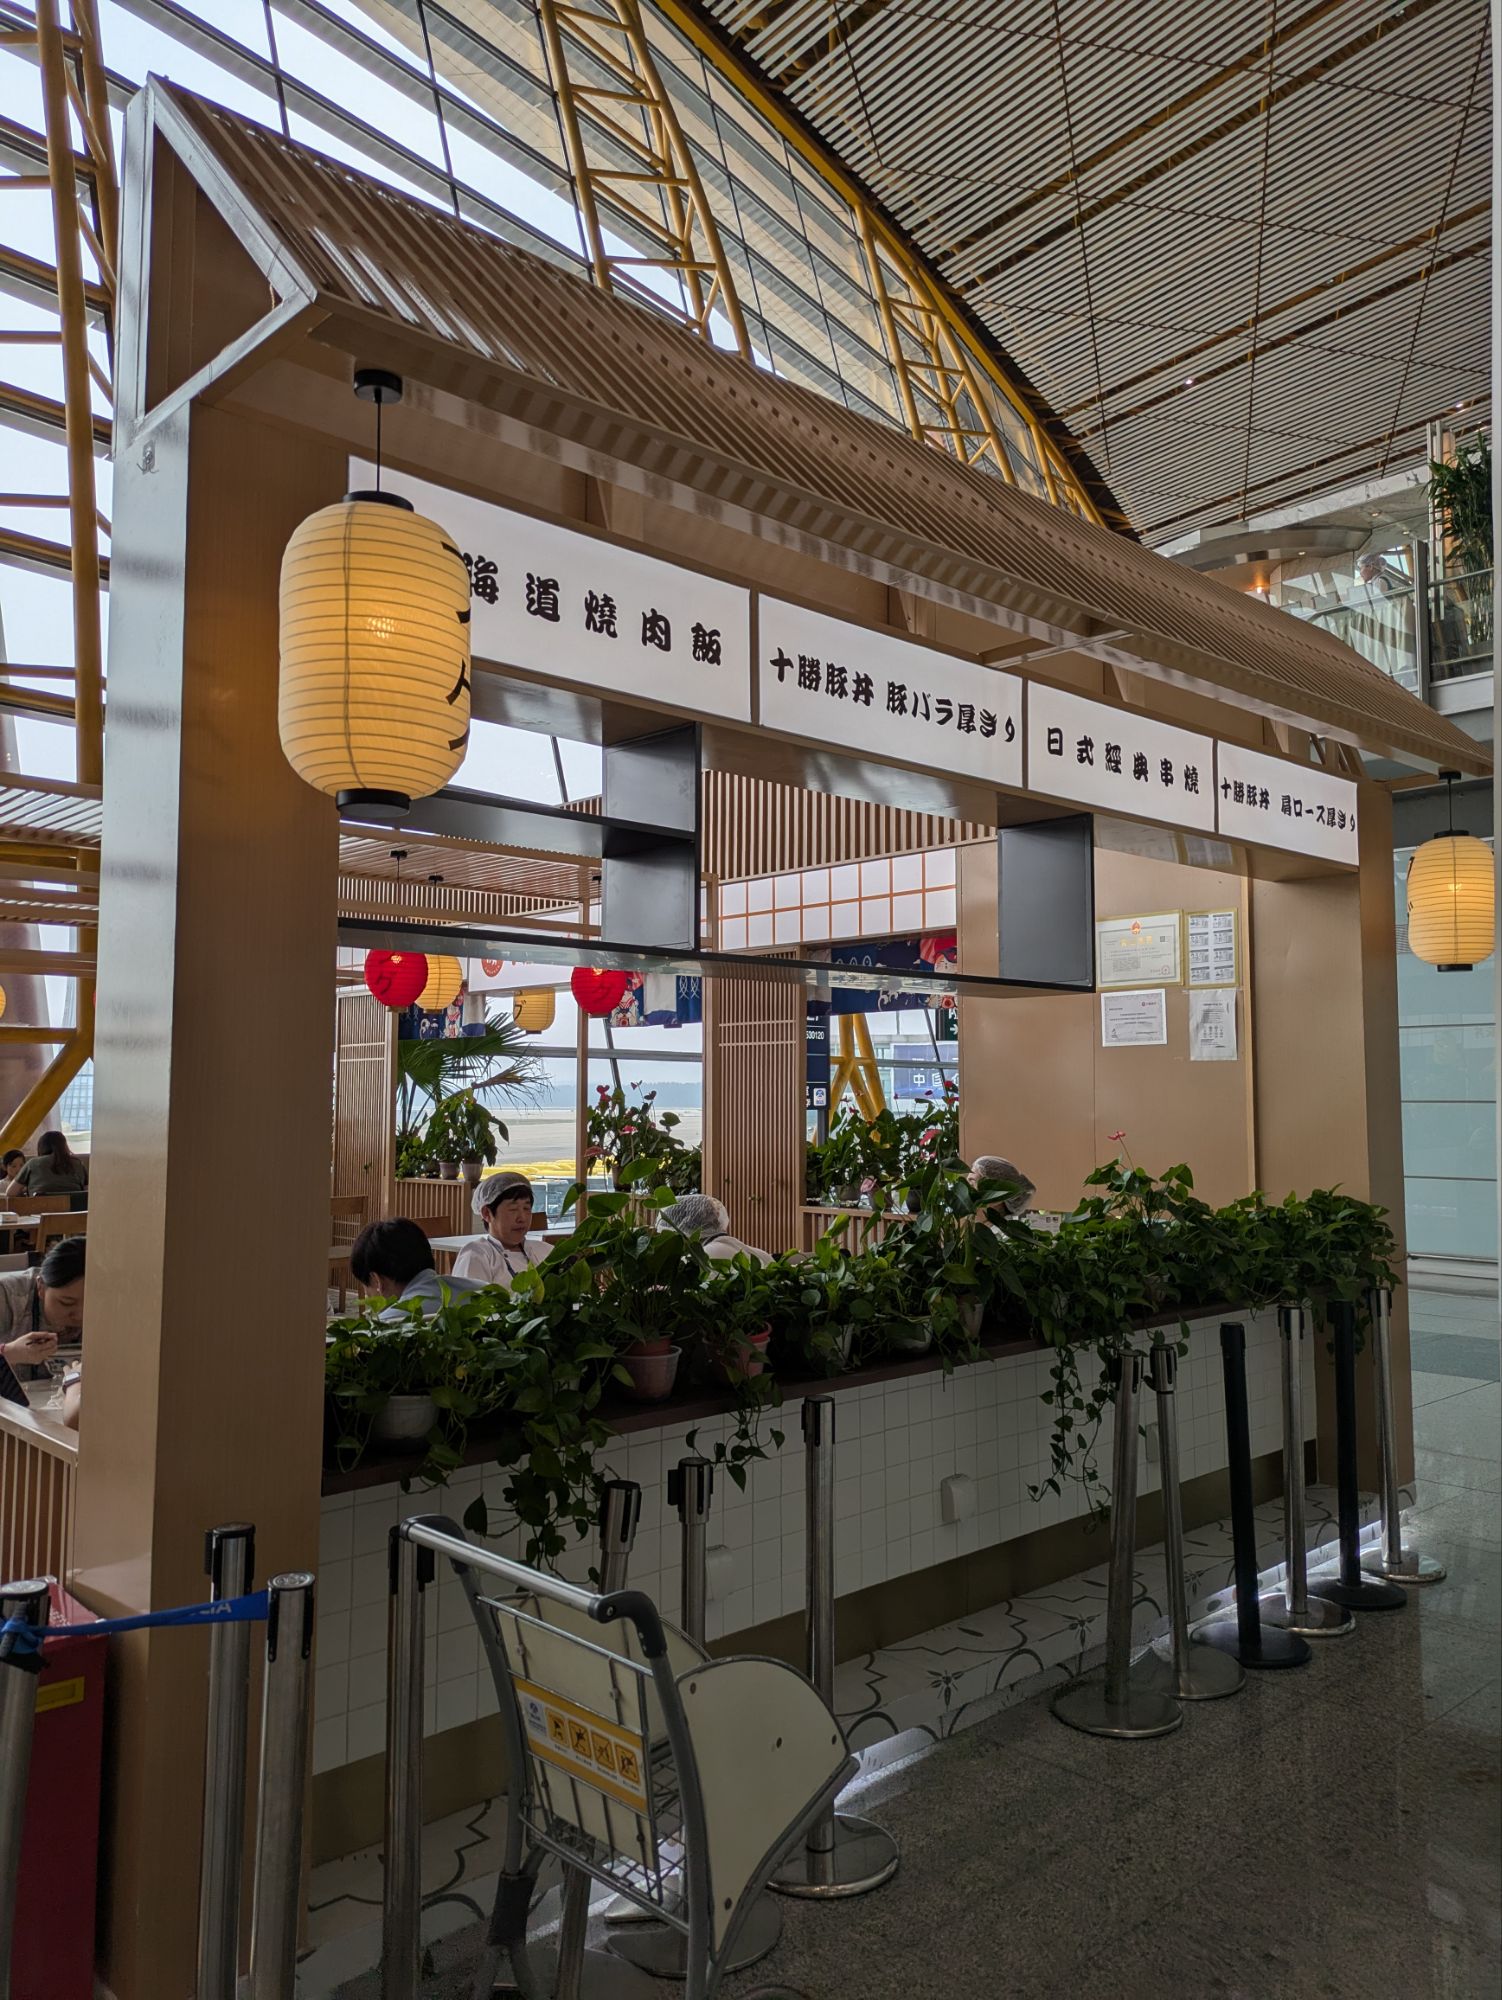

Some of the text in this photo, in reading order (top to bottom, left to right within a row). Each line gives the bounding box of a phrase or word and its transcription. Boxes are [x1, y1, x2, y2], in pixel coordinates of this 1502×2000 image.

[1047, 727, 1200, 795] 日式經典串燒
